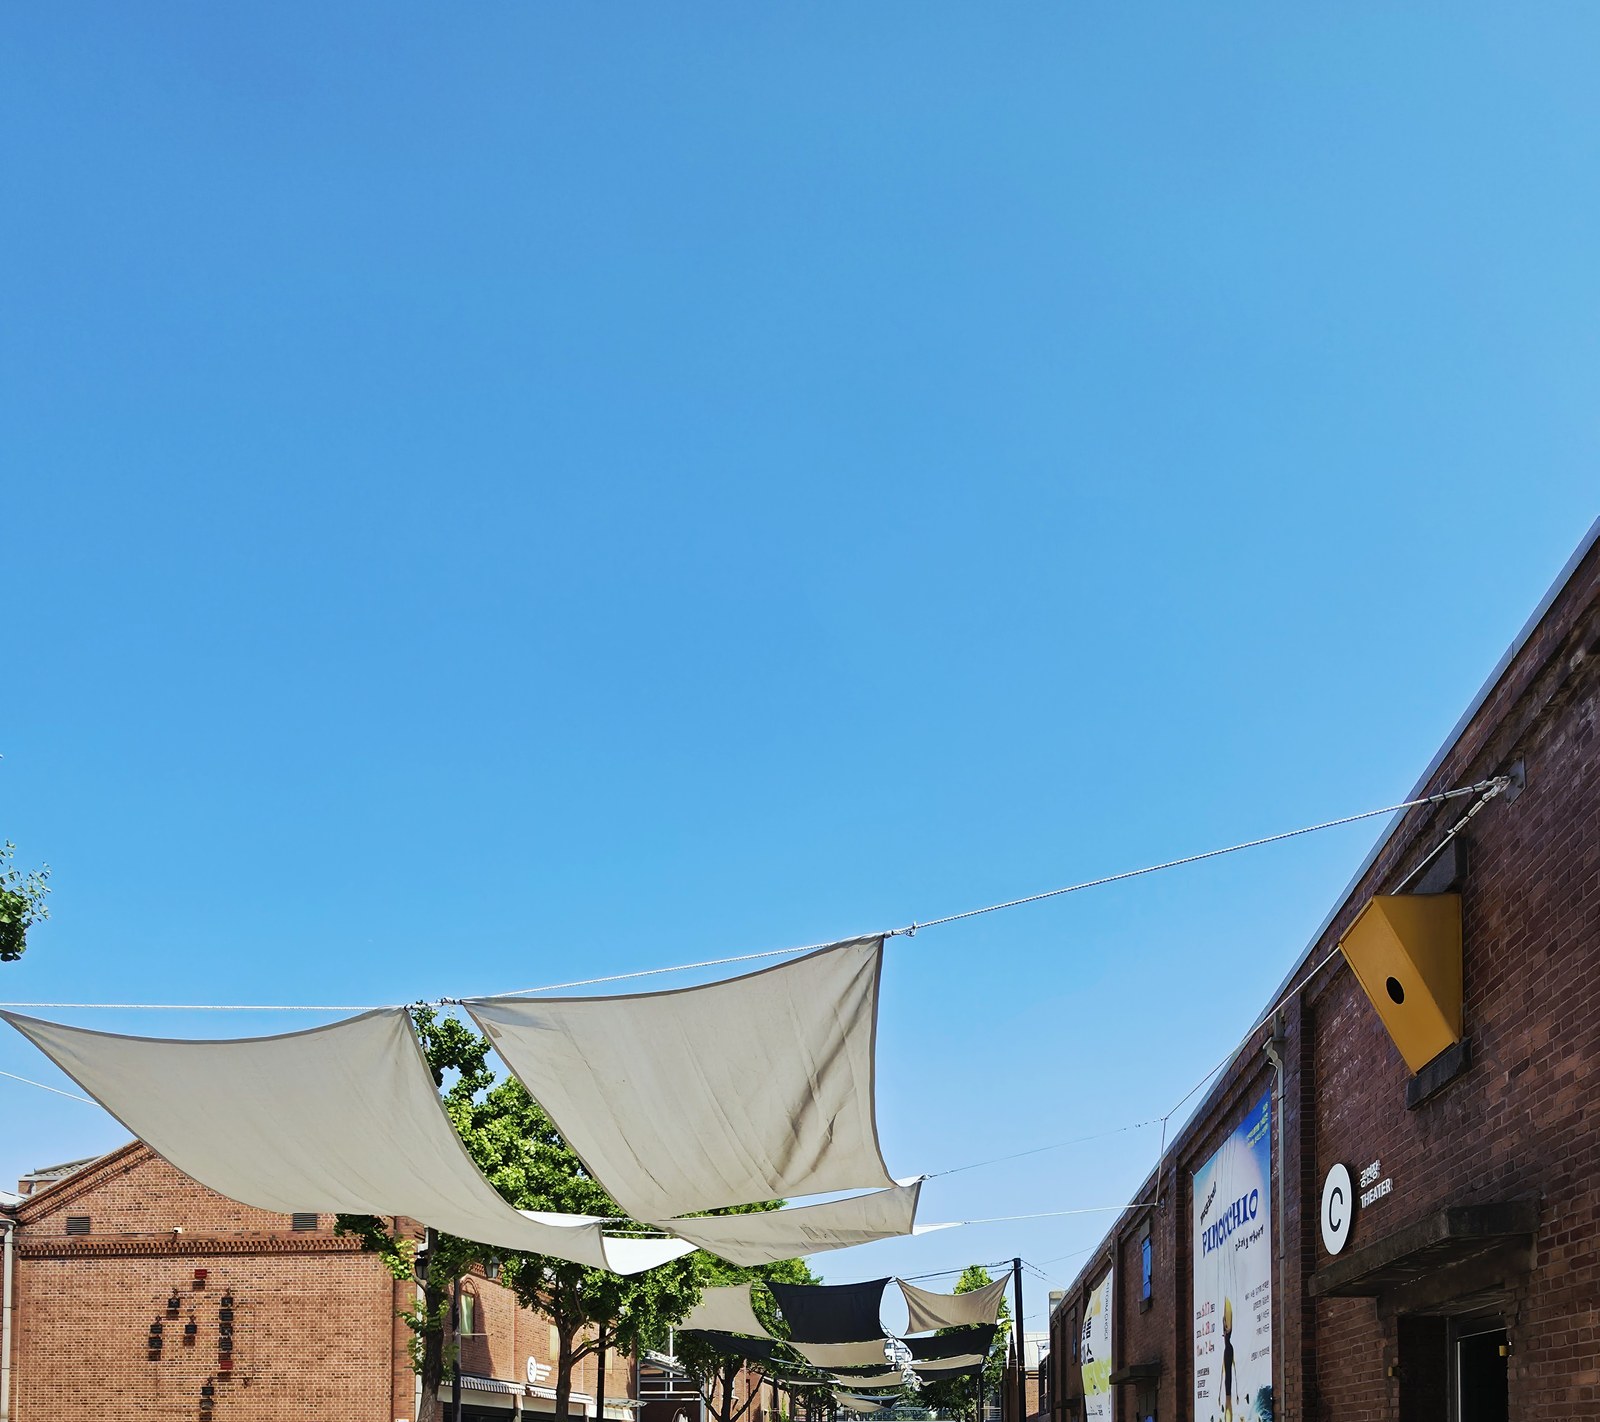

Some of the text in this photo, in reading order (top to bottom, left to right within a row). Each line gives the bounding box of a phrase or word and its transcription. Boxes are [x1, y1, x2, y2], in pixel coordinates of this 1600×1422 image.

[1359, 1159, 1381, 1188] 공연장
[1329, 1186, 1344, 1233] C
[1359, 1178, 1393, 1209] THEATER
[1202, 1188, 1258, 1258] PINOCCHIO
